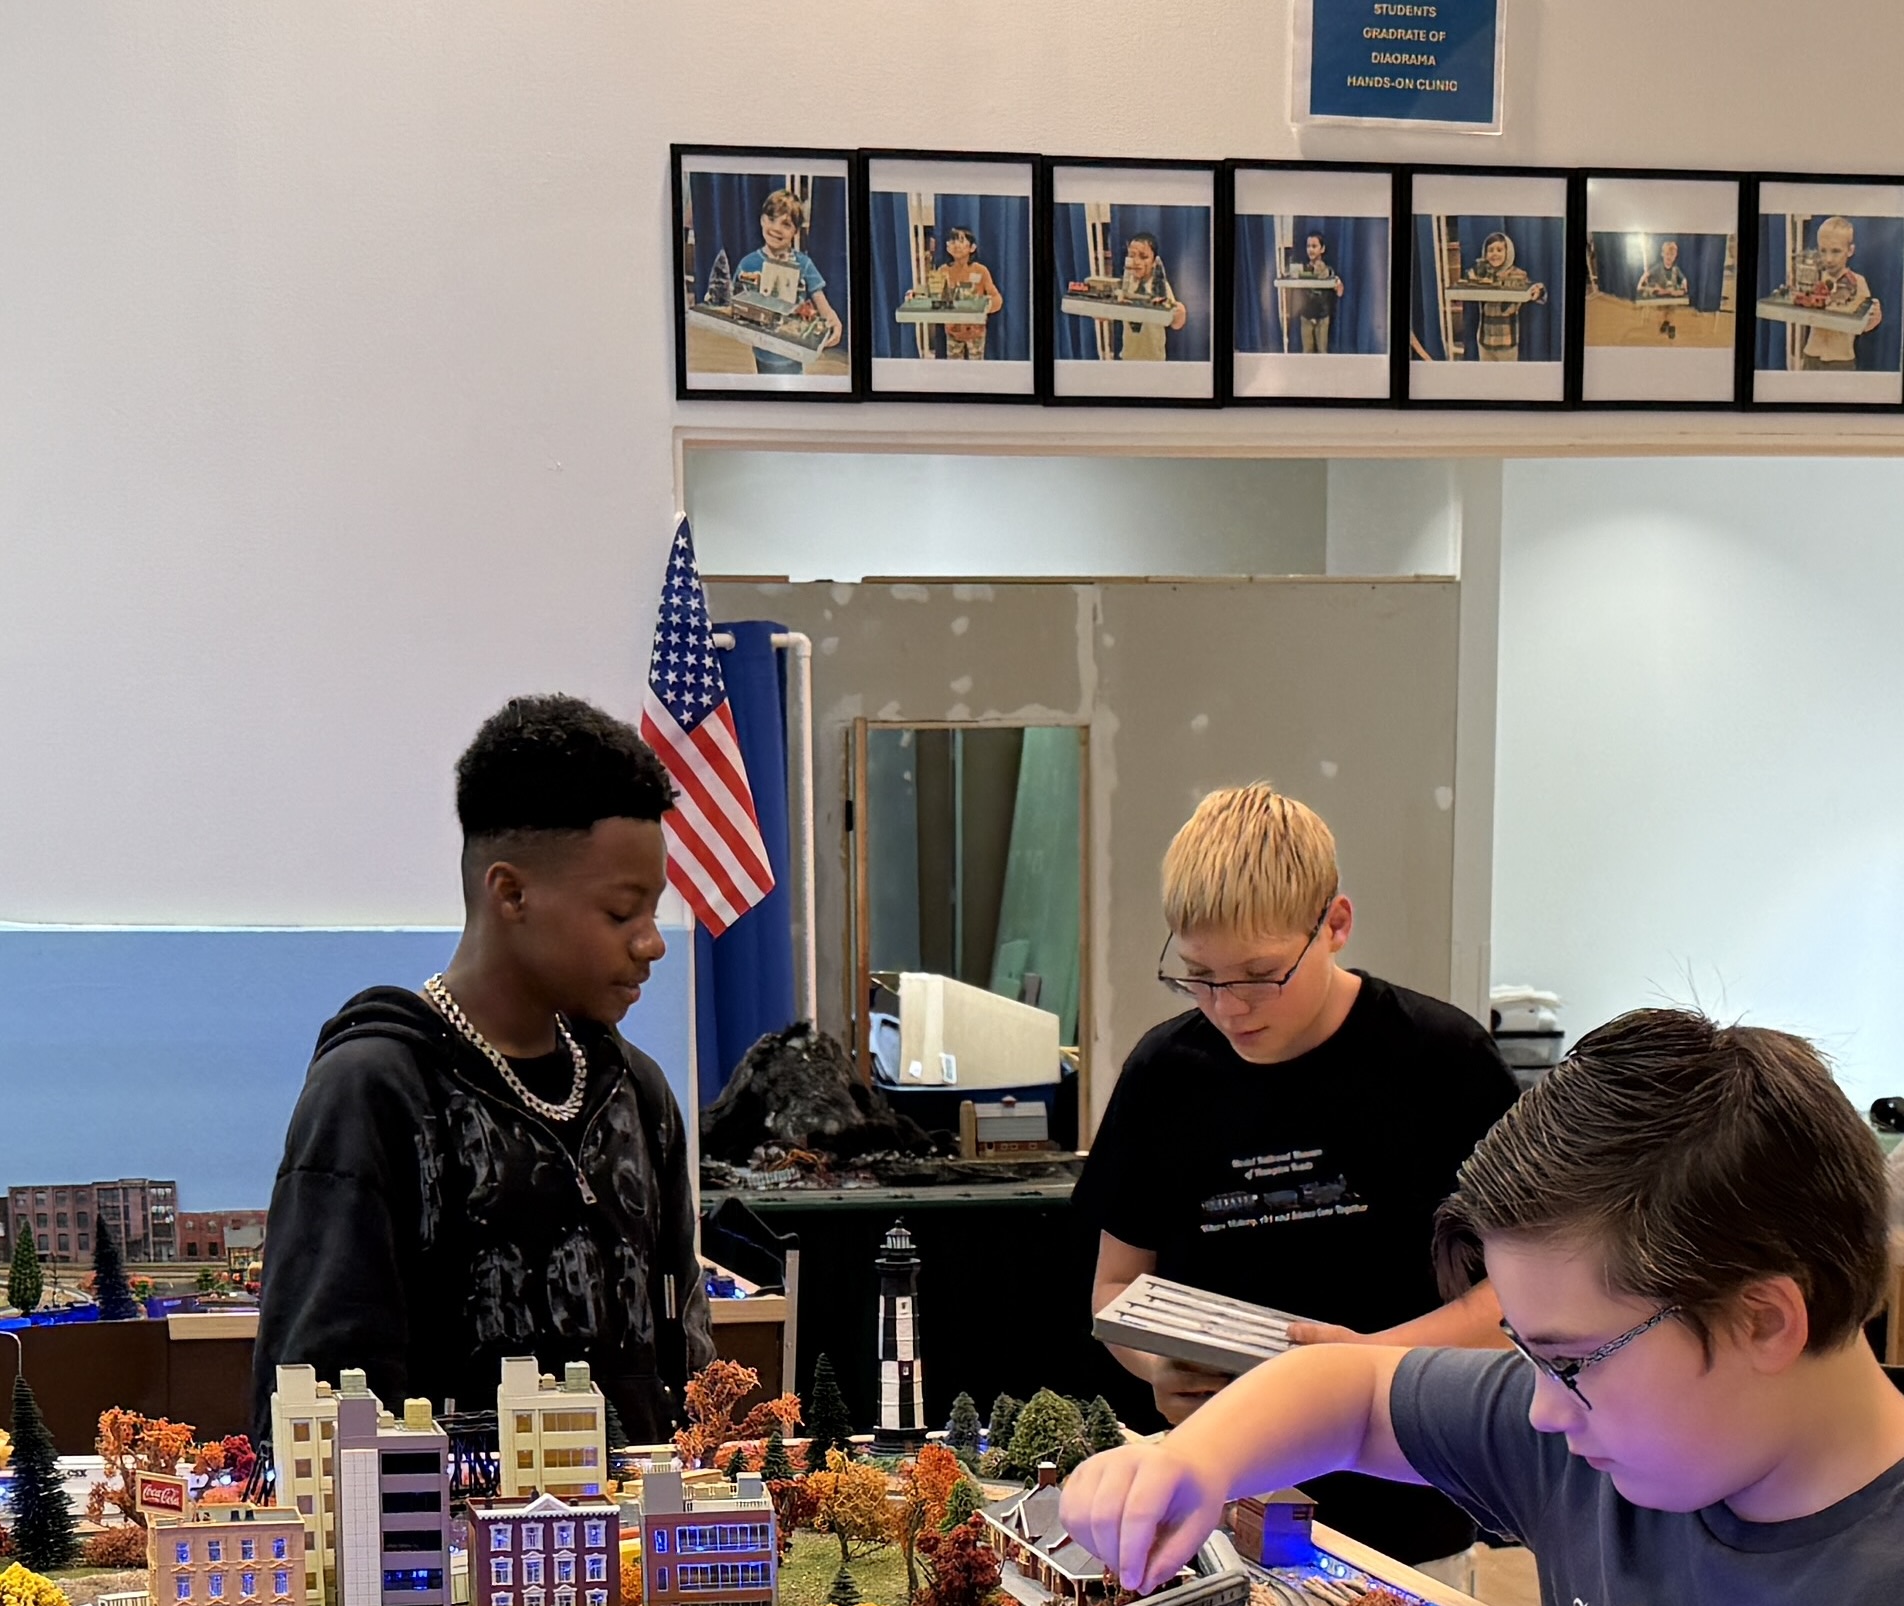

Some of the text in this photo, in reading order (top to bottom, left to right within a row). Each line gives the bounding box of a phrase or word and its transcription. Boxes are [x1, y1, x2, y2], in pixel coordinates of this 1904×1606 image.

[1374, 3, 1437, 17] STUDENTS
[1428, 30, 1447, 42] OF
[1347, 75, 1414, 89] HANDS-ON
